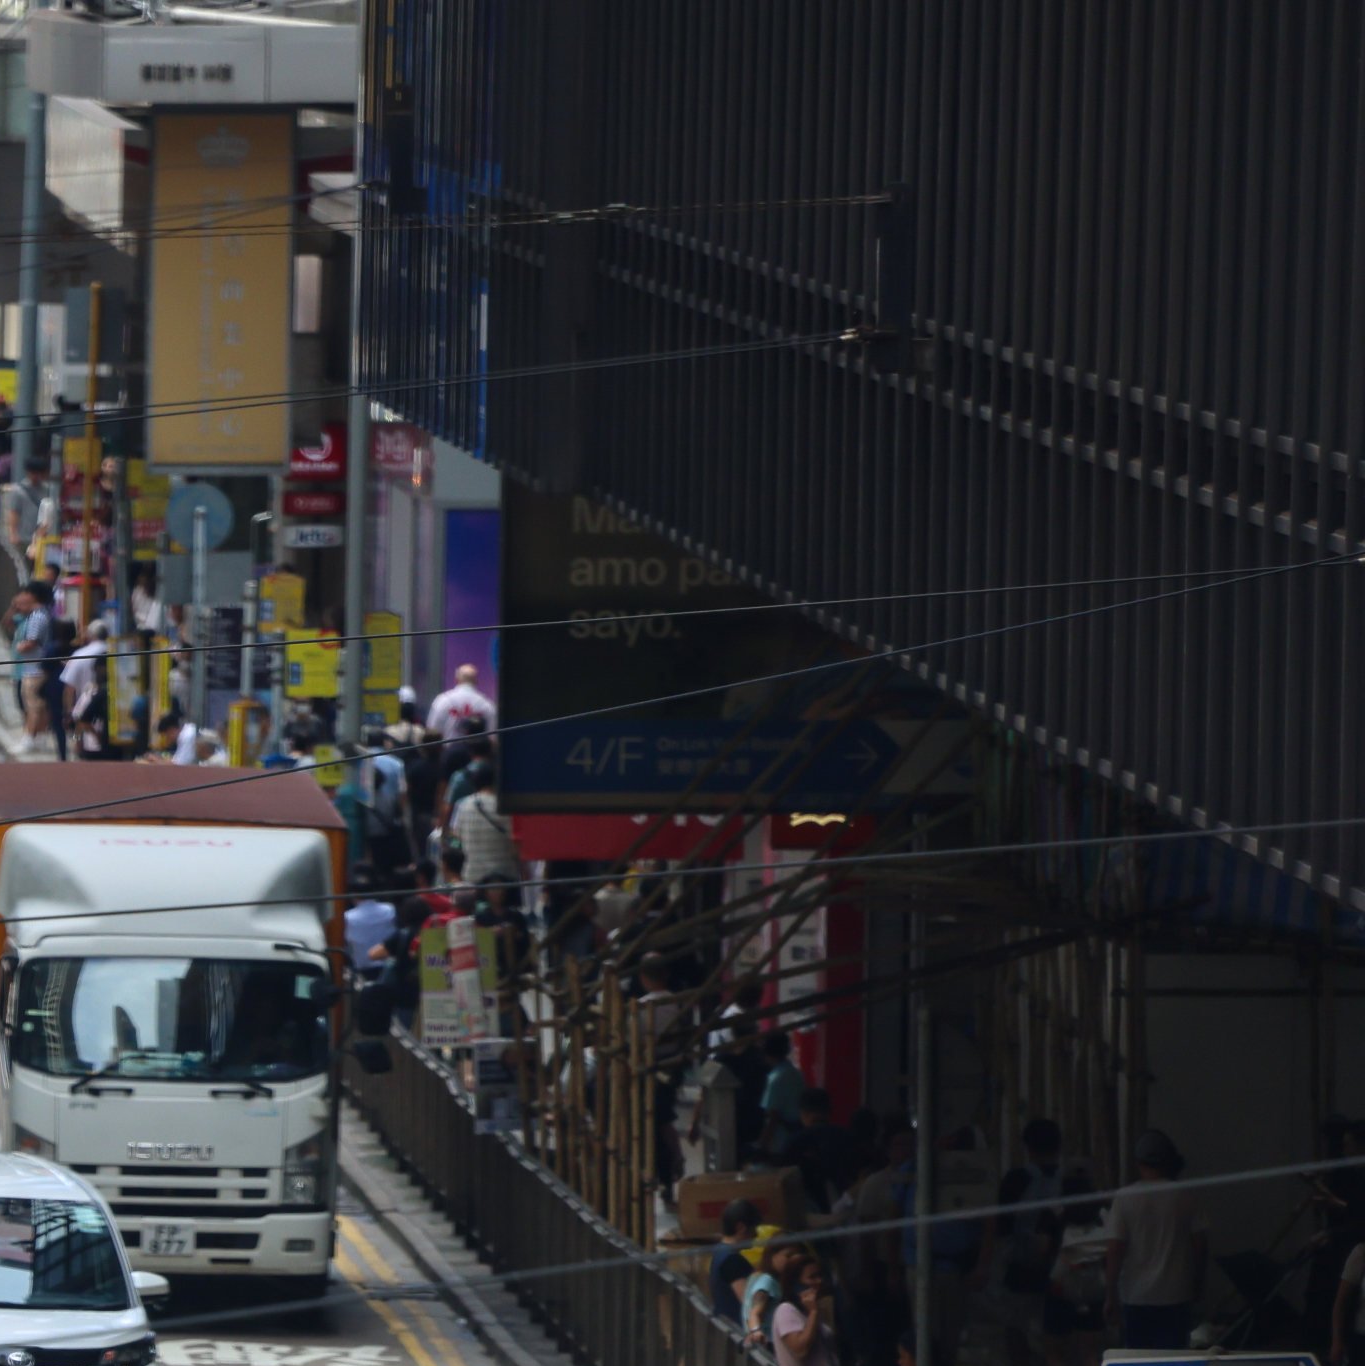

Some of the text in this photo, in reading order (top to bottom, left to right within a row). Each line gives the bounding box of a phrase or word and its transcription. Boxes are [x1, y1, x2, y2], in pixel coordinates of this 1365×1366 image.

[569, 557, 667, 588] amo
[566, 736, 646, 777] 4/F
[127, 1142, 215, 1161] ISUZU
